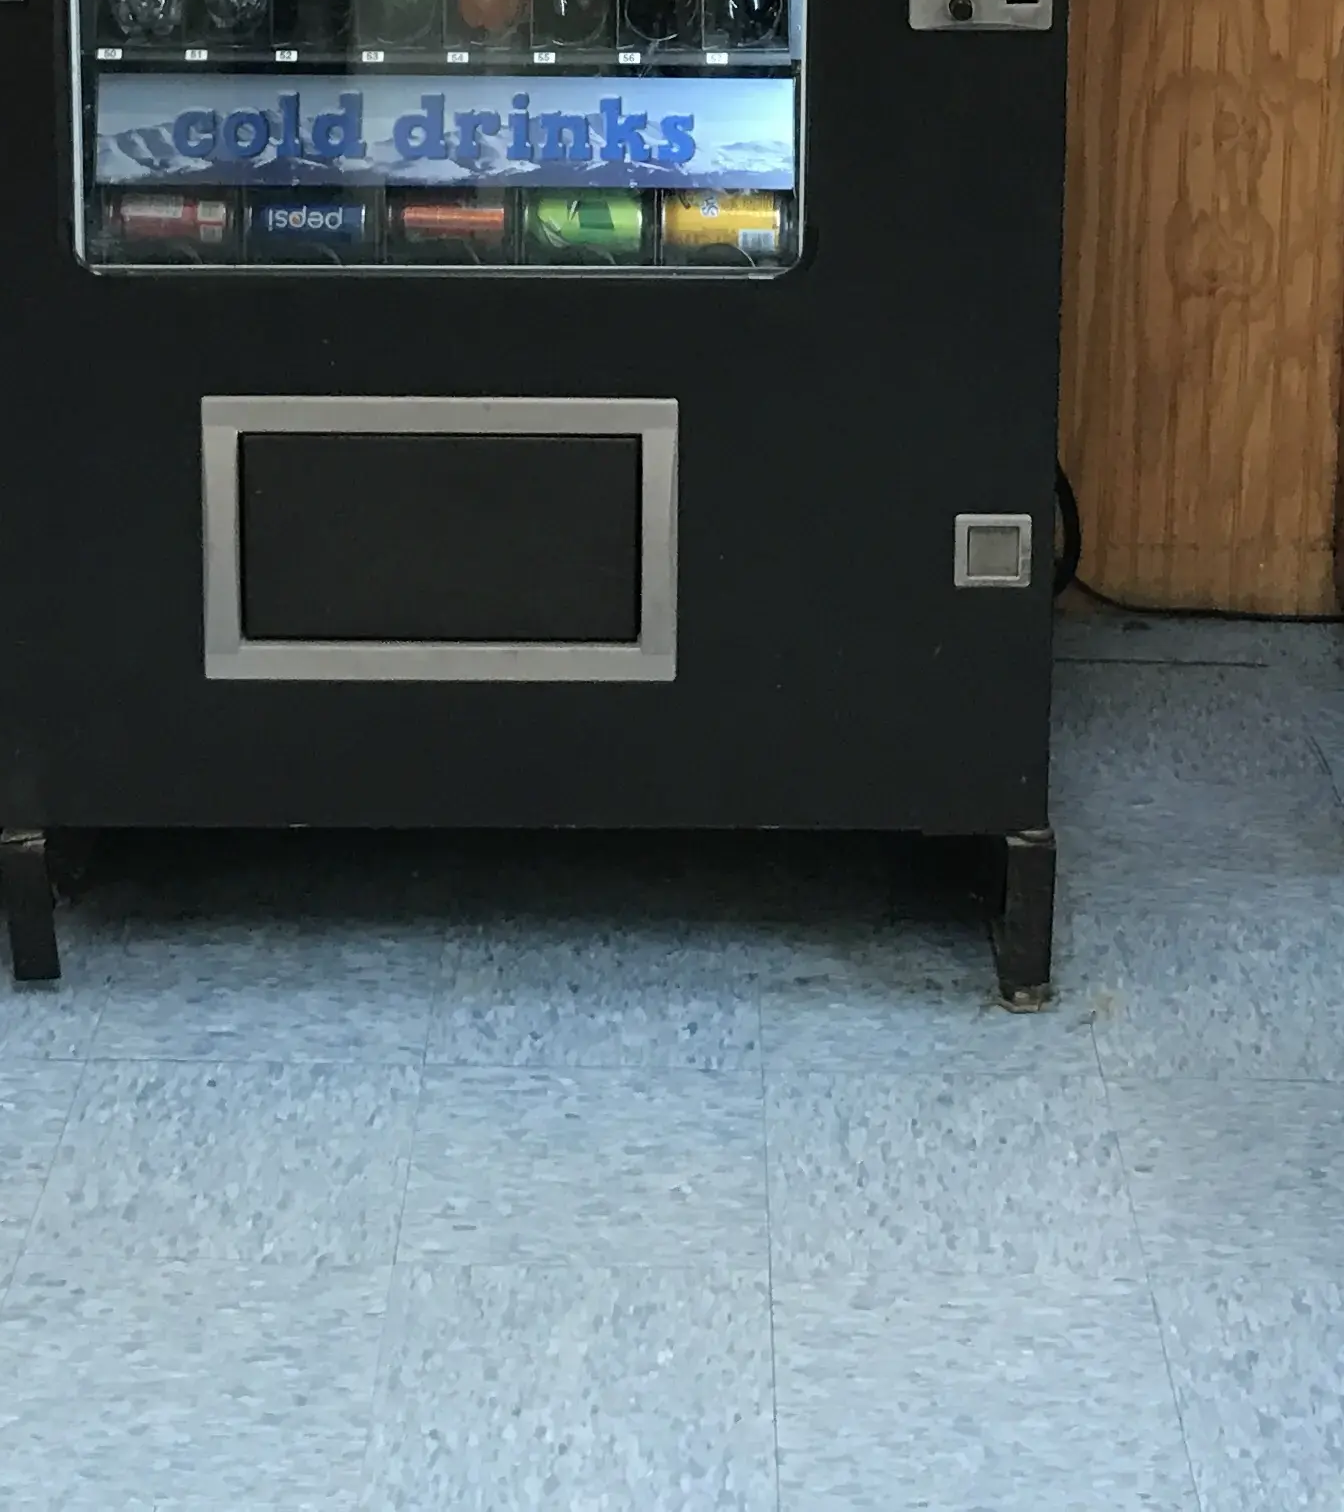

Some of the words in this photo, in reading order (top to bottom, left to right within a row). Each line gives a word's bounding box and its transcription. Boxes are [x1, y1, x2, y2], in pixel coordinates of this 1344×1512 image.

[173, 92, 366, 161] cold
[393, 92, 697, 164] drinks
[267, 205, 344, 232] pepsi
